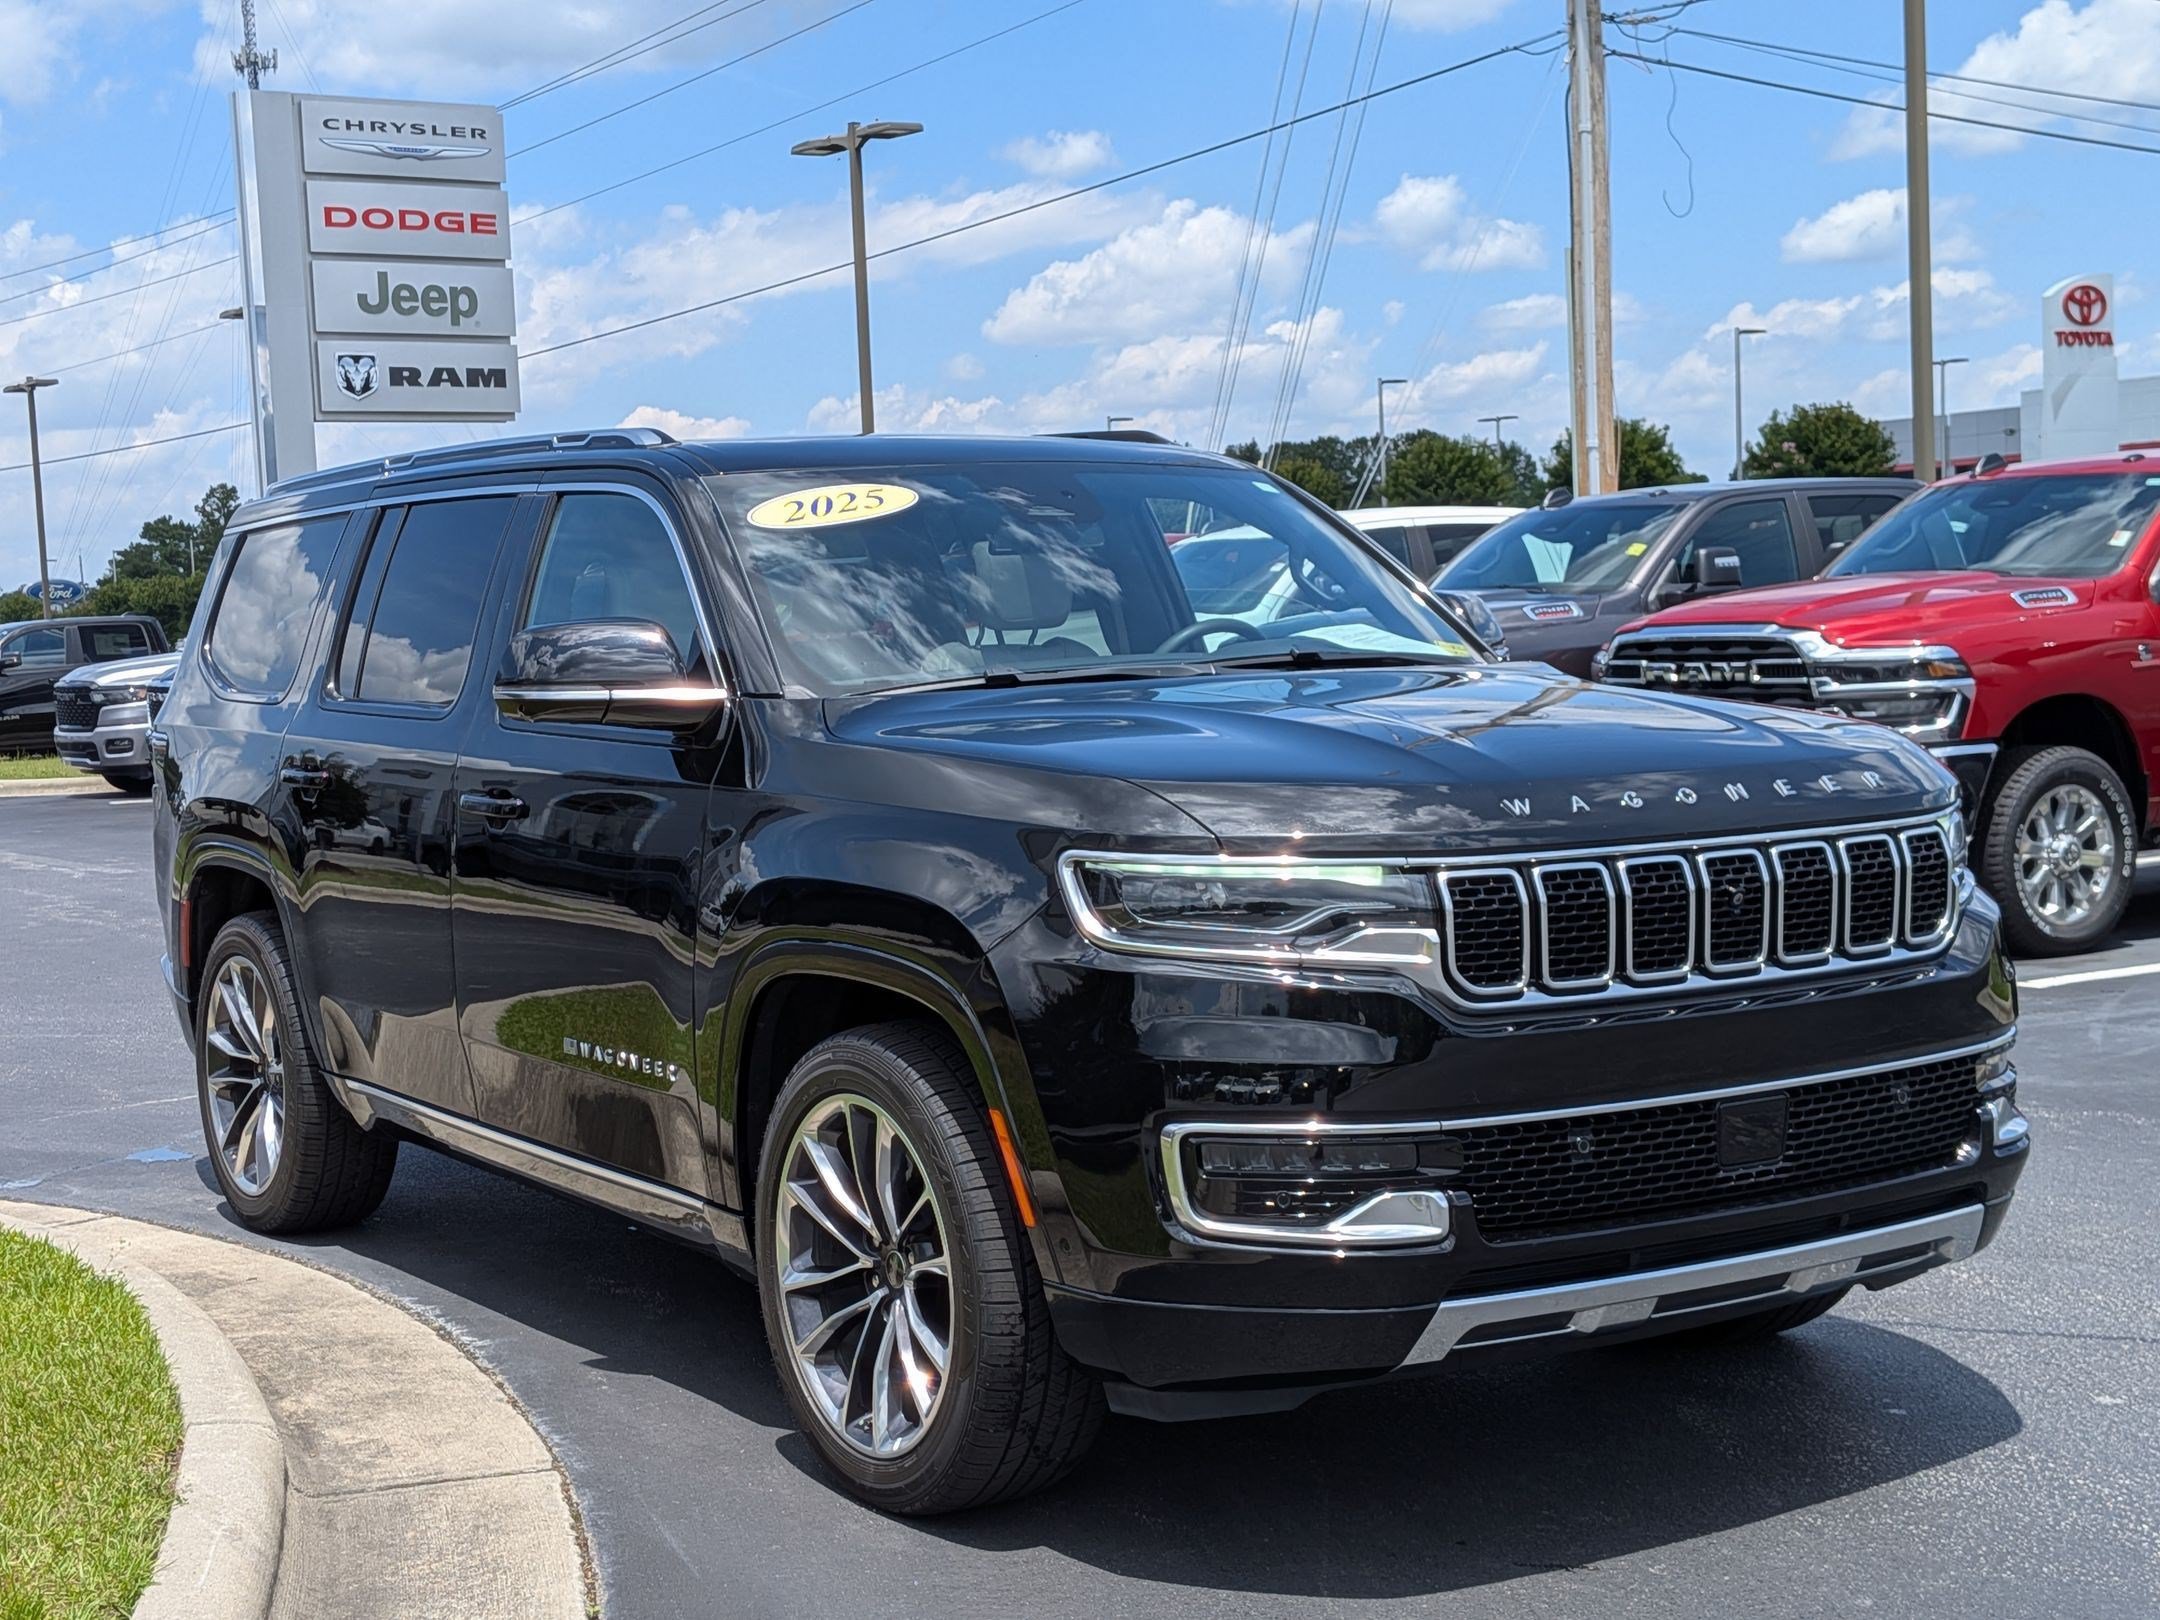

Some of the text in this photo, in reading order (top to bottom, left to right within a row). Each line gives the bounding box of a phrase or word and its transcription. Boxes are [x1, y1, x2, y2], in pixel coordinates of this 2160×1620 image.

[322, 118, 487, 140] CHRYSLER
[323, 206, 498, 235] DODGE
[356, 271, 478, 327] Jeep
[2054, 331, 2113, 348] TOYOTA
[388, 366, 507, 388] RAM
[783, 488, 884, 523] 2025
[1645, 661, 1748, 683] RAM
[1500, 770, 1886, 817] WAGONEER
[580, 1041, 679, 1082] WAGONEER
